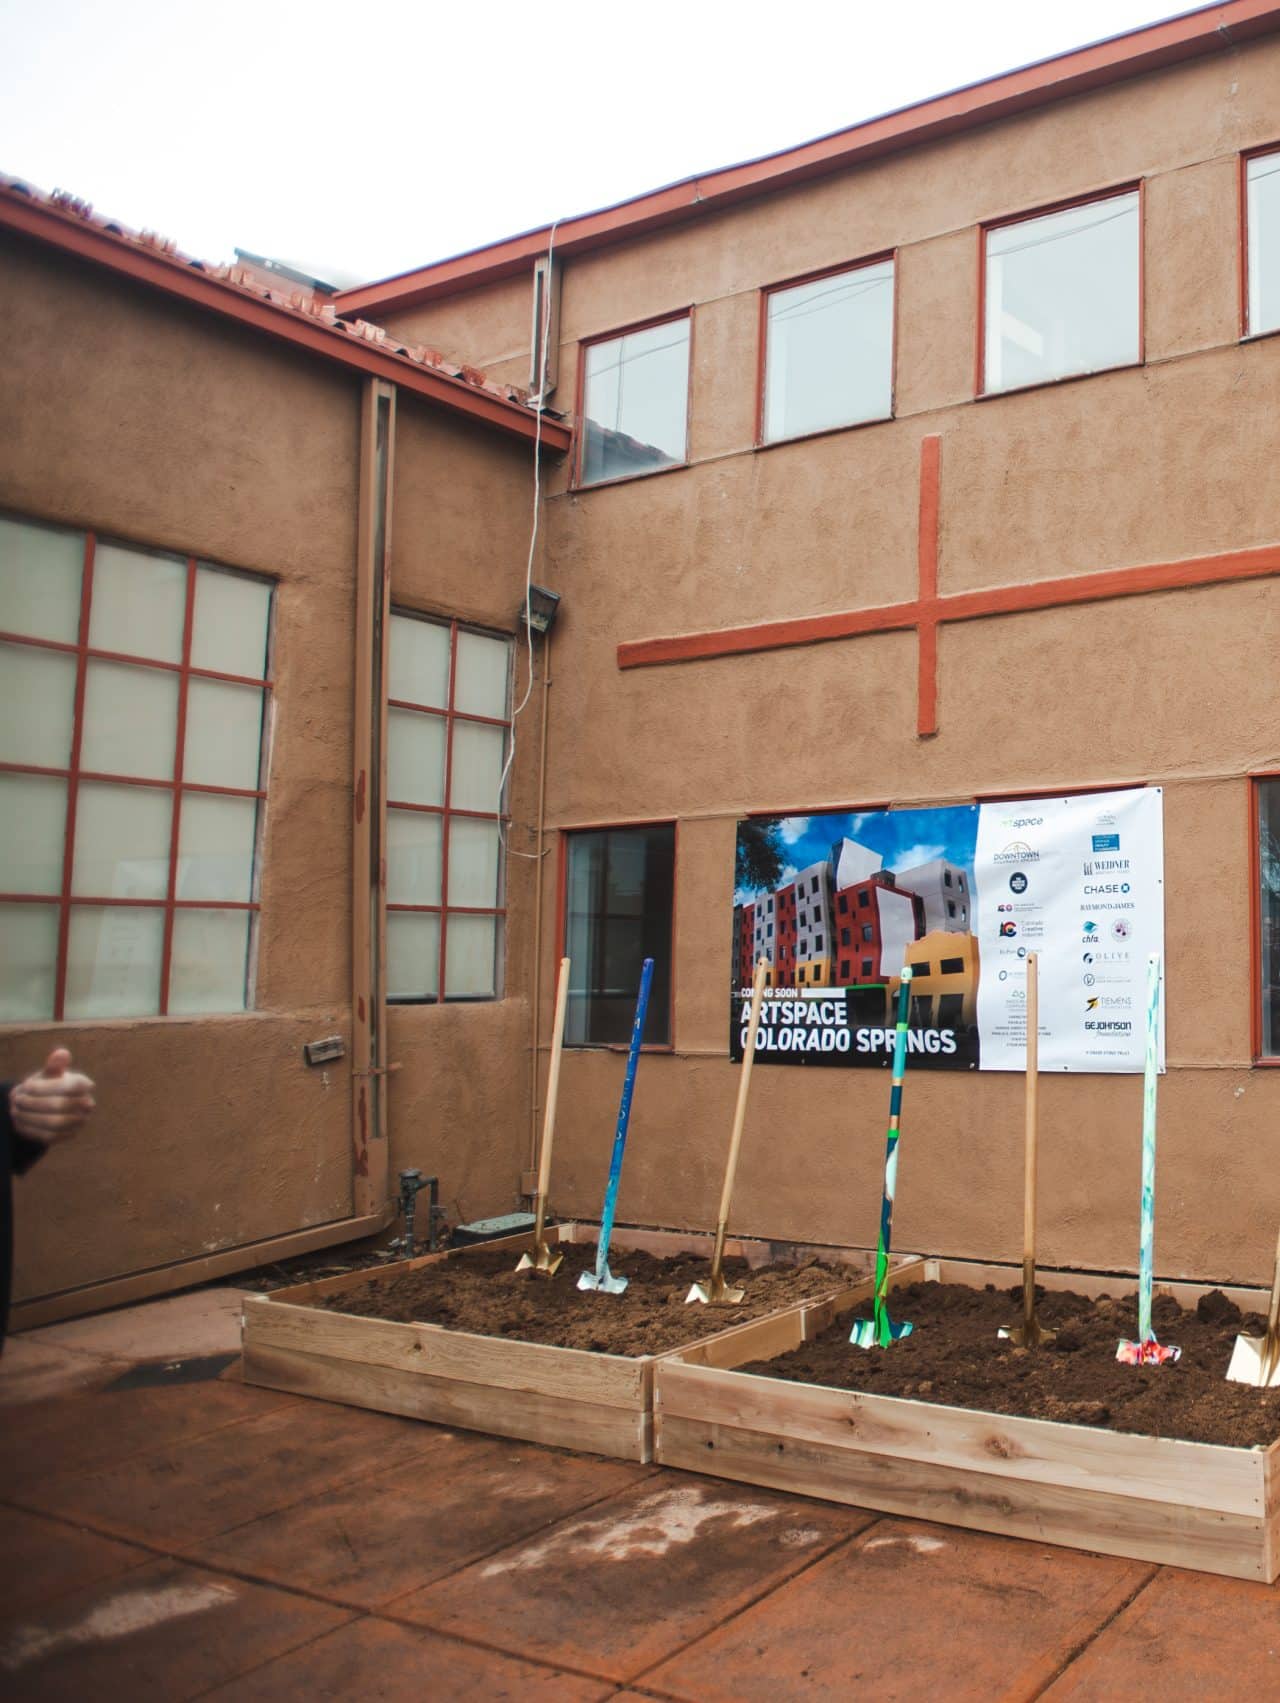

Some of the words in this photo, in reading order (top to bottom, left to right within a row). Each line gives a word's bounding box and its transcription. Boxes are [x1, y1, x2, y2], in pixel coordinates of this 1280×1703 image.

[993, 850, 1040, 861] DOWNTOWN
[1094, 859, 1130, 870] WEIDNER
[1083, 884, 1119, 895] CHASE
[741, 987, 774, 998] CONG
[775, 988, 798, 998] SOON
[856, 1028, 957, 1054] SPRNGS
